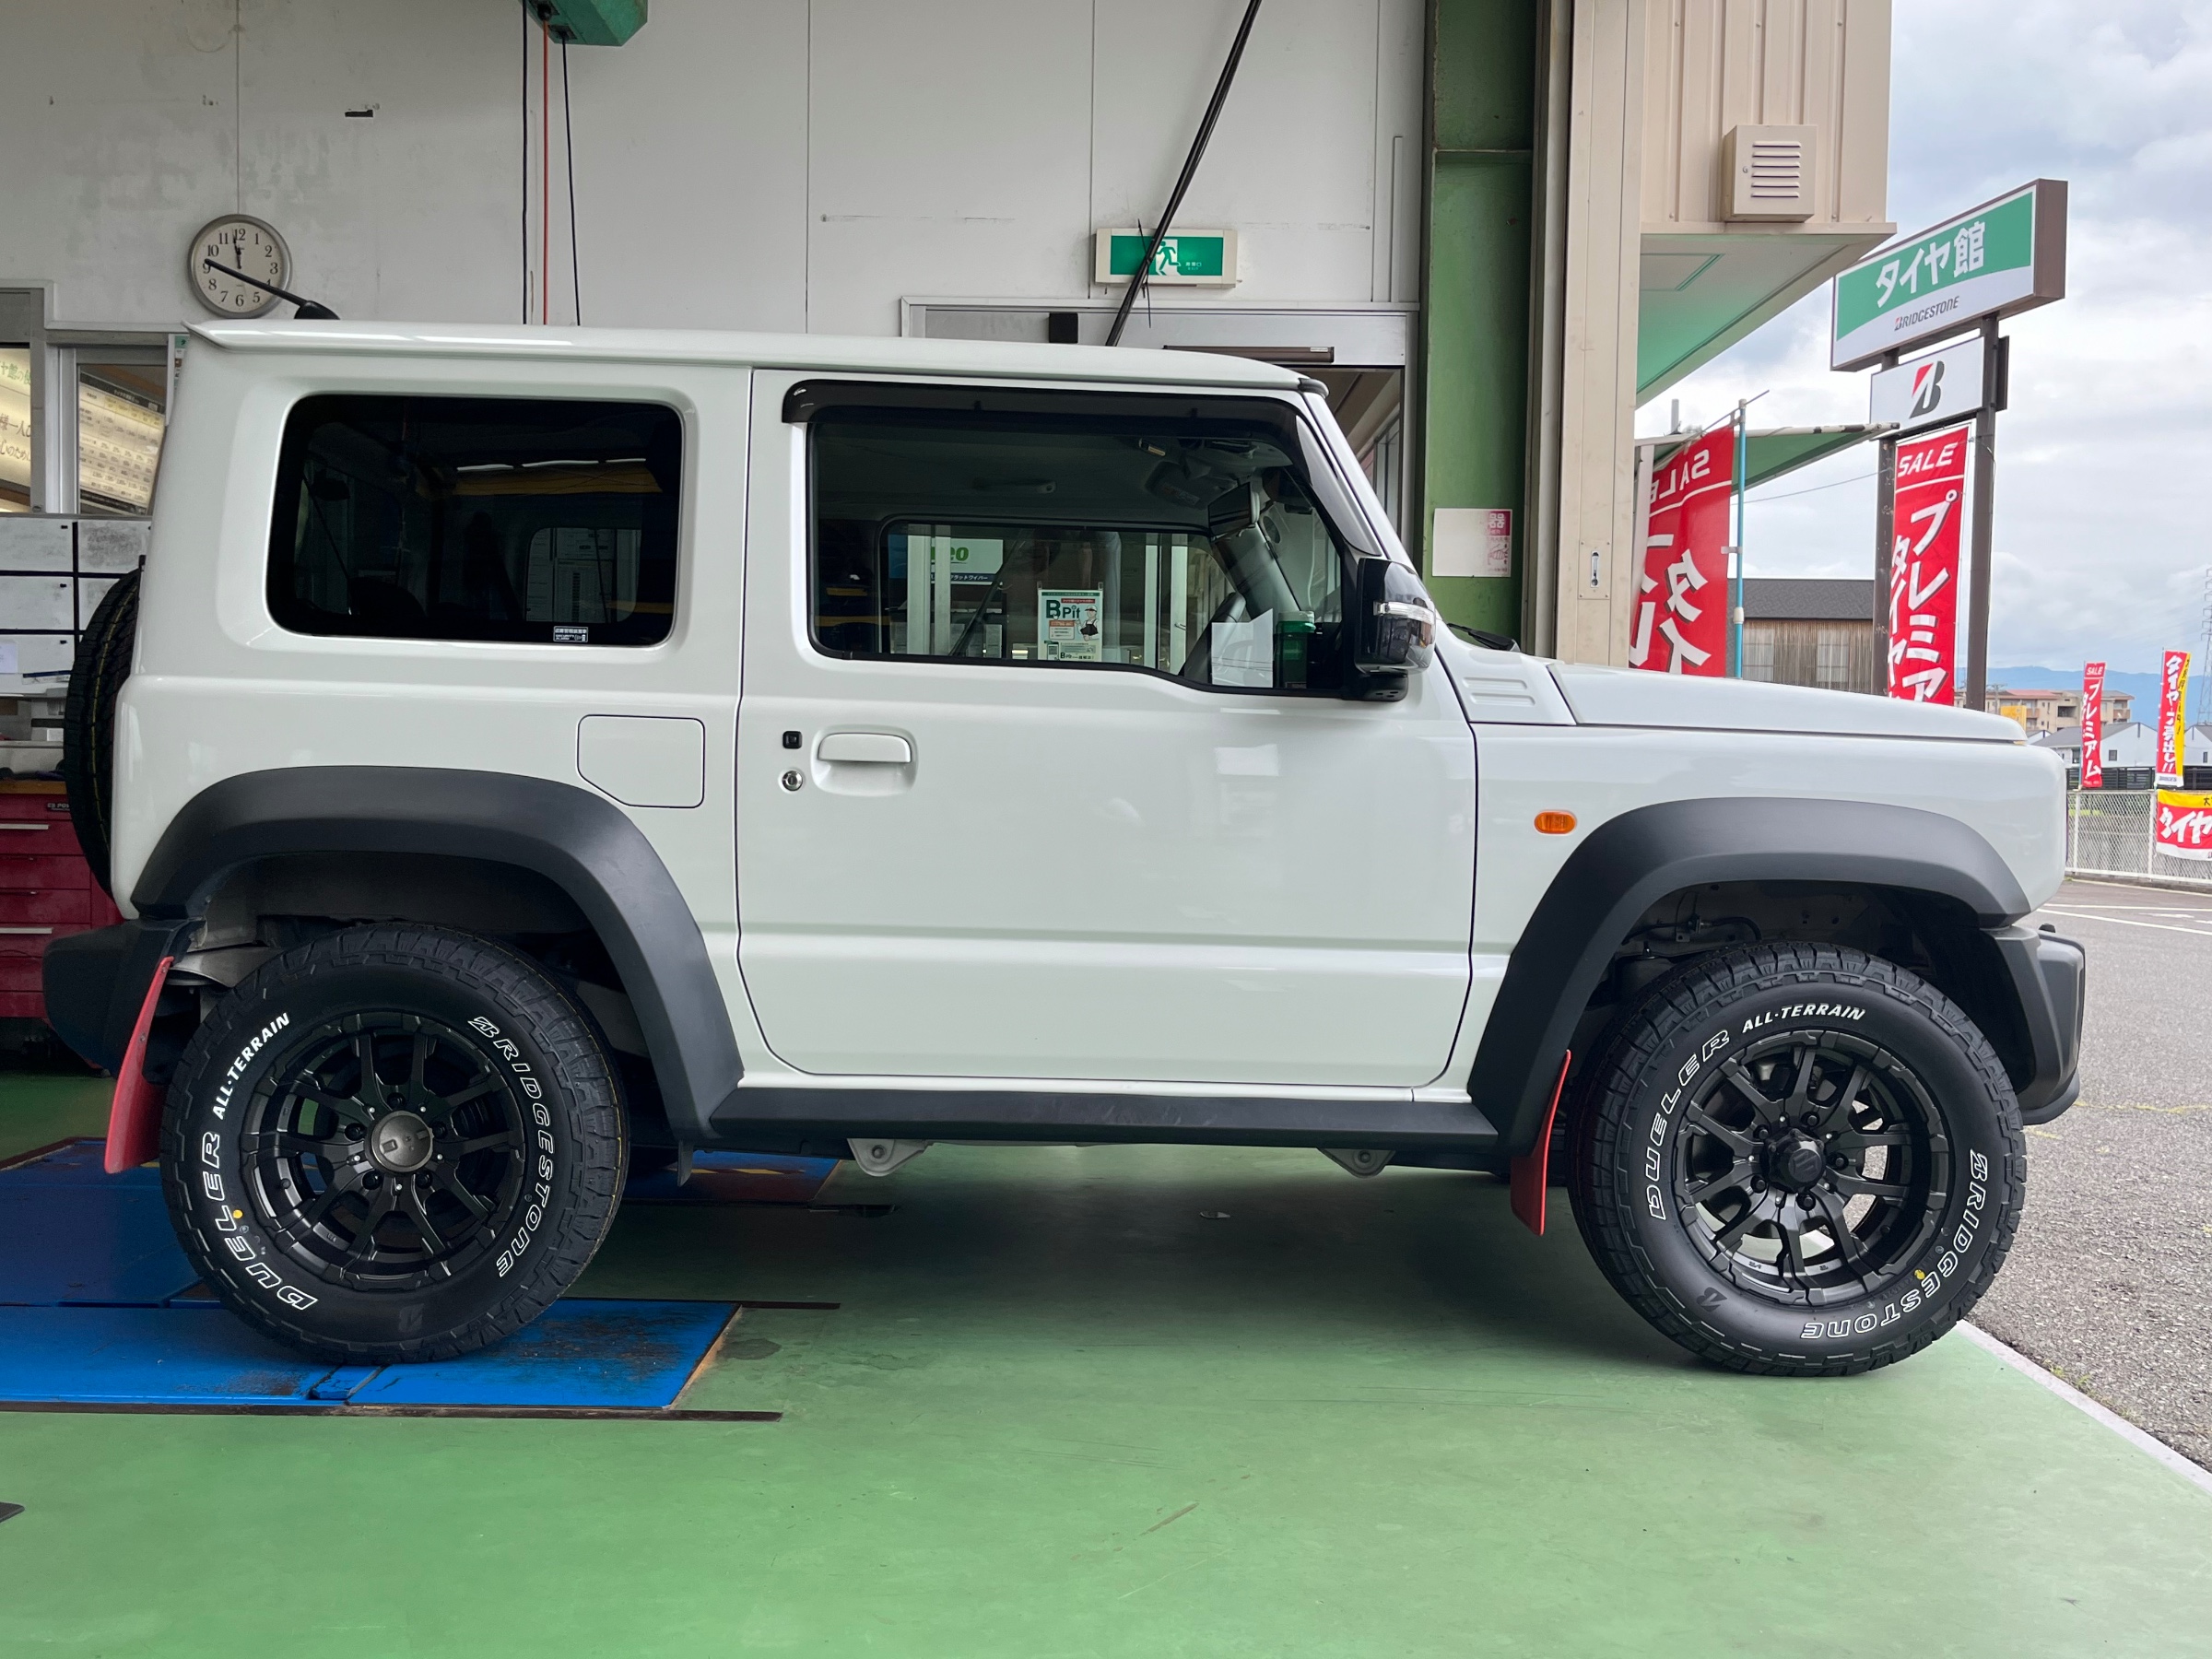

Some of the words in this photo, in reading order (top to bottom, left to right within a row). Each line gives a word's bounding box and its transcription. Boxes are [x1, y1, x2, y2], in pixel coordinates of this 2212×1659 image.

[219, 233, 229, 244] 11
[234, 229, 246, 241] 12
[207, 245, 219, 257] 10
[265, 245, 272, 257] 2
[270, 263, 278, 275] 3
[1875, 221, 1985, 308] タイヤ館
[208, 278, 217, 290] 8
[220, 291, 229, 302] 7
[235, 295, 244, 307] 6
[253, 292, 260, 303] 5
[1894, 296, 1959, 331] BRIDGESTONE
[1898, 441, 1958, 477] SALE
[2086, 666, 2103, 676] SALE
[2159, 806, 2212, 844] タイヤ
[1645, 1030, 1730, 1220] DUELER
[467, 1017, 554, 1277] BRIDGESTONE
[201, 1132, 318, 1311] DUELER
[1801, 1149, 1988, 1339] BRIDGESTONE
